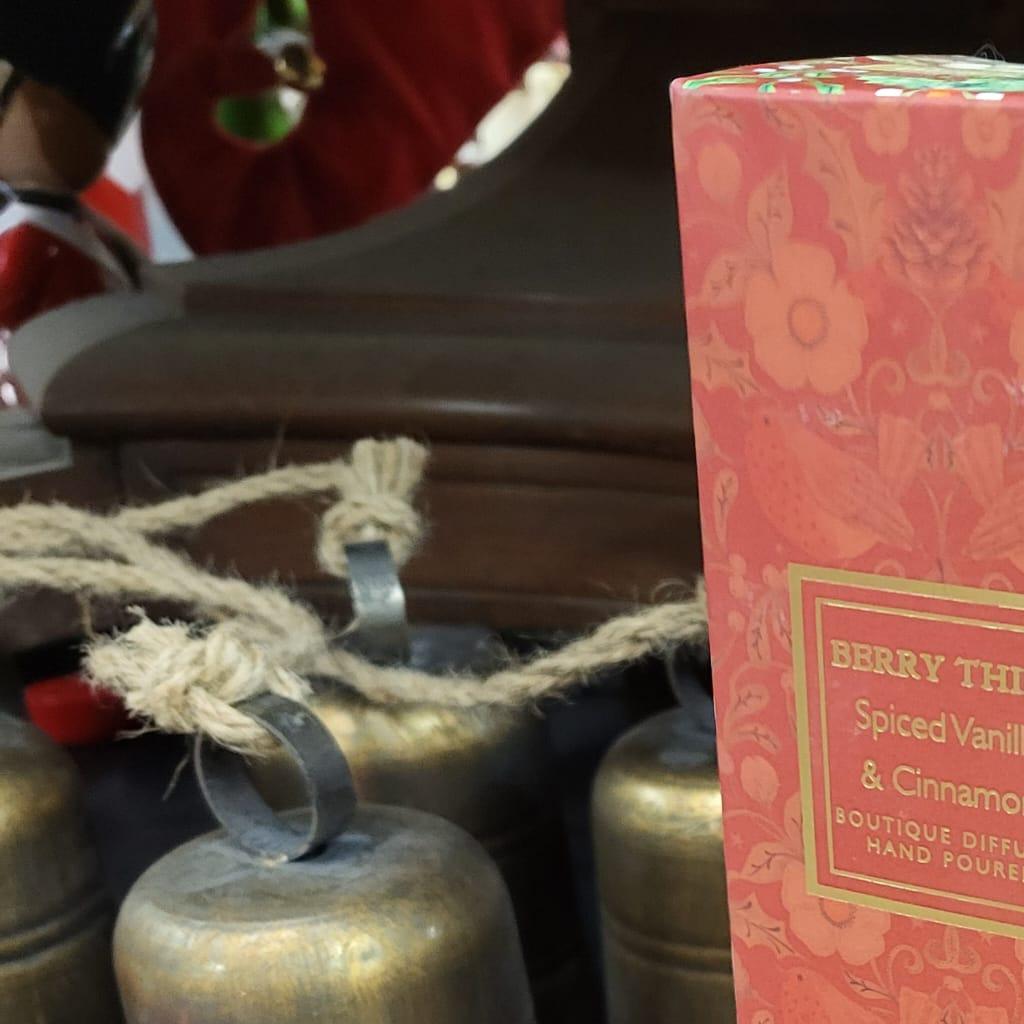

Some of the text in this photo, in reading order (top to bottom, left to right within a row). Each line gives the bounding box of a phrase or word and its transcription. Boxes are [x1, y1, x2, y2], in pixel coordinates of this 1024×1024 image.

[830, 639, 946, 683] BERRY
[855, 698, 947, 741] Spiced
[860, 759, 884, 791] &
[835, 806, 951, 846] BOUTIQUE
[866, 836, 932, 864] HAND
